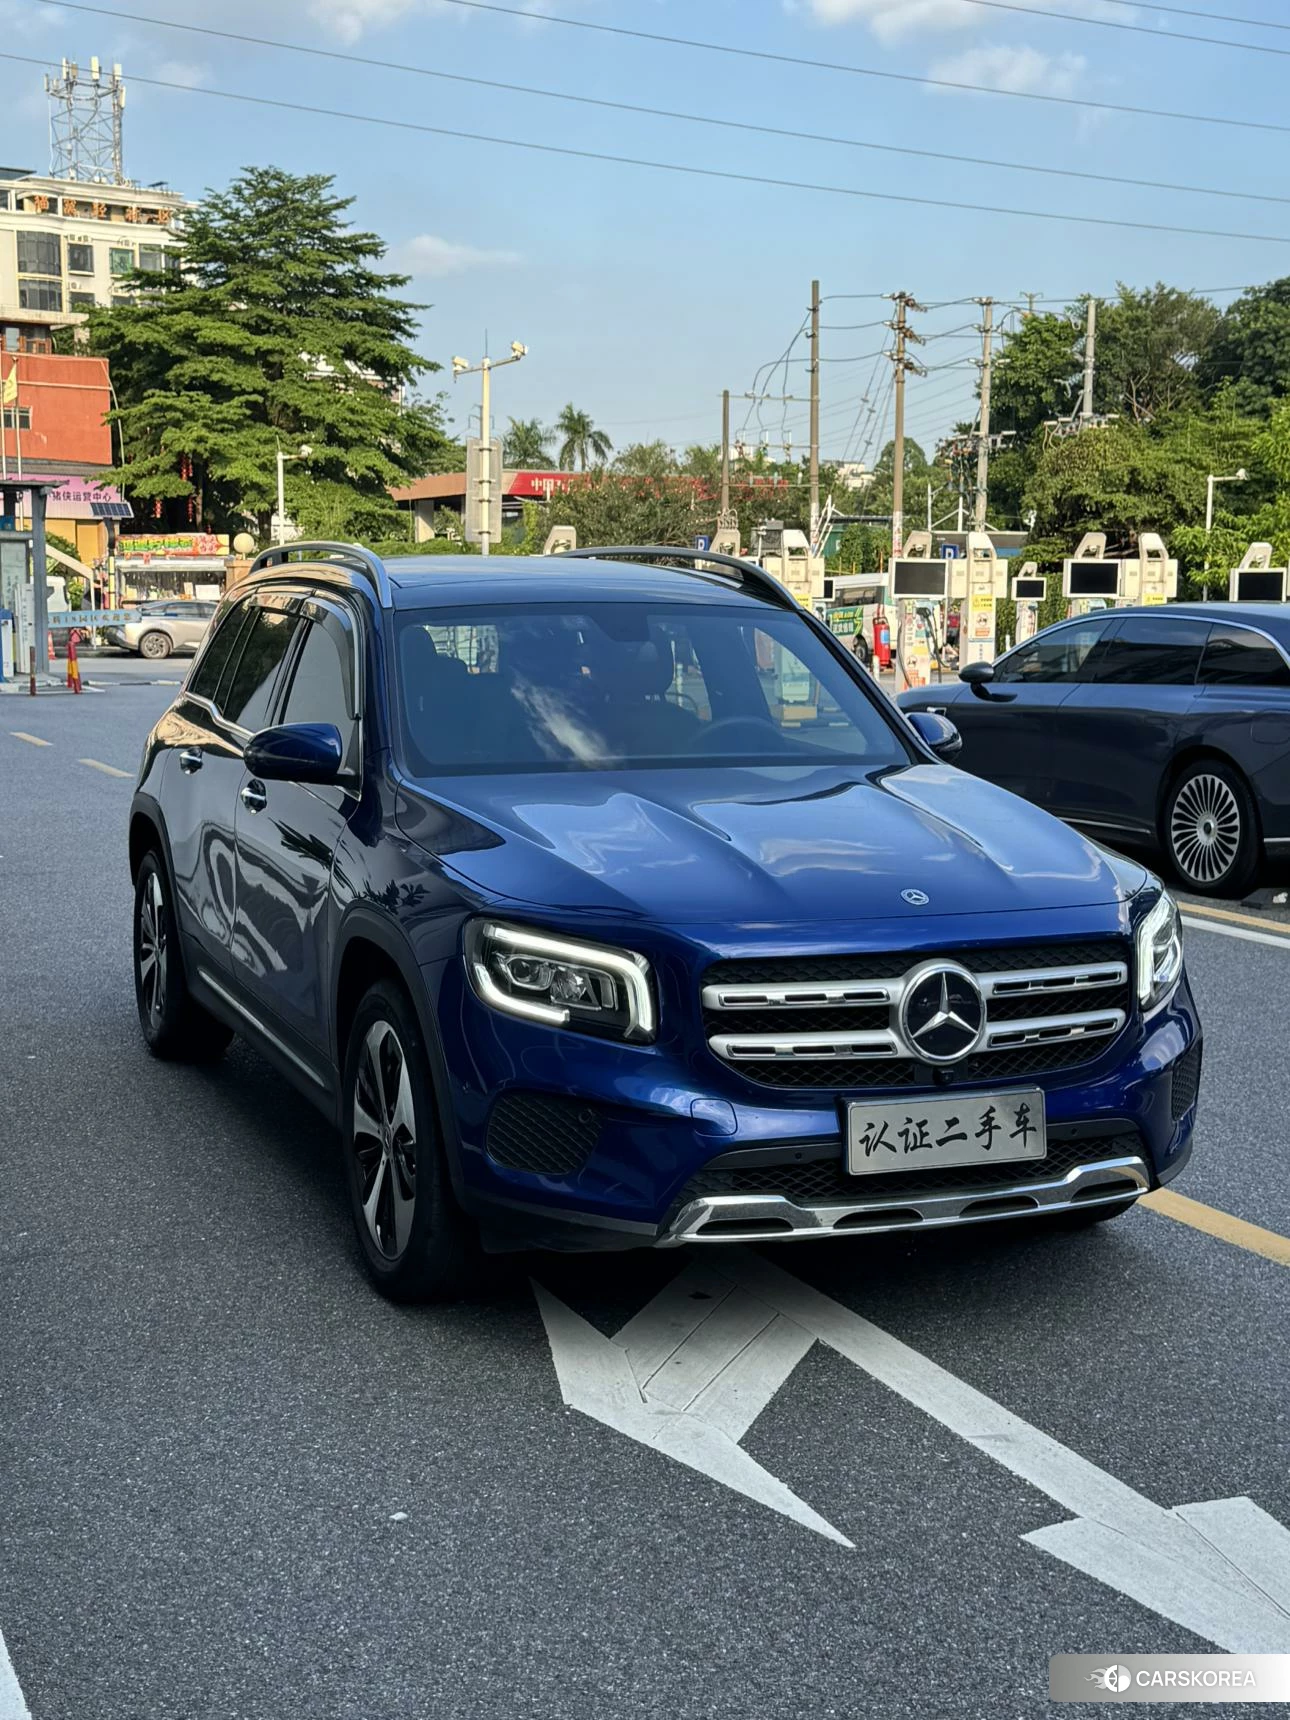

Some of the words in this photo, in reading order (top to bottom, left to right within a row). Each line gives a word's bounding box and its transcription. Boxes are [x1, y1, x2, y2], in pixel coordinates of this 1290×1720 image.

[859, 1102, 1037, 1157] 认证二手车
